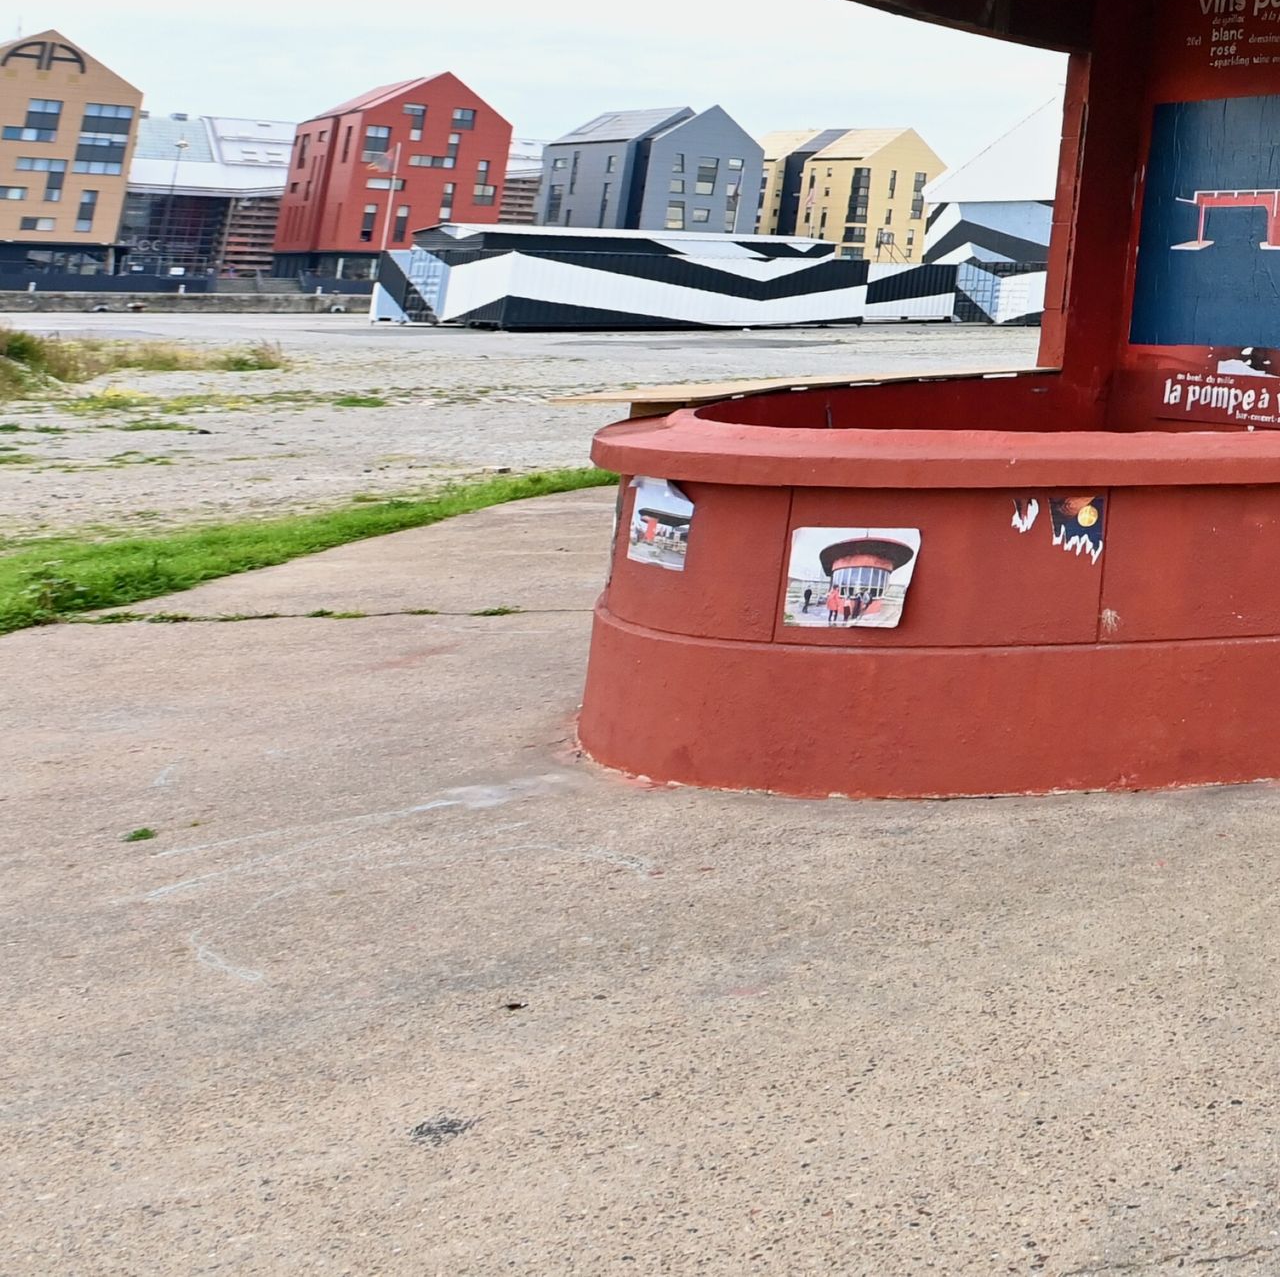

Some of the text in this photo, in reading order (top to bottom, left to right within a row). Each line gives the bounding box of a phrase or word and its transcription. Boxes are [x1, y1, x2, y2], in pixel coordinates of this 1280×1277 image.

[1211, 26, 1244, 42] blanc
[1210, 41, 1237, 56] rosé
[1163, 378, 1182, 405] la
[1185, 384, 1256, 415] pompe
[1257, 387, 1270, 409] à
